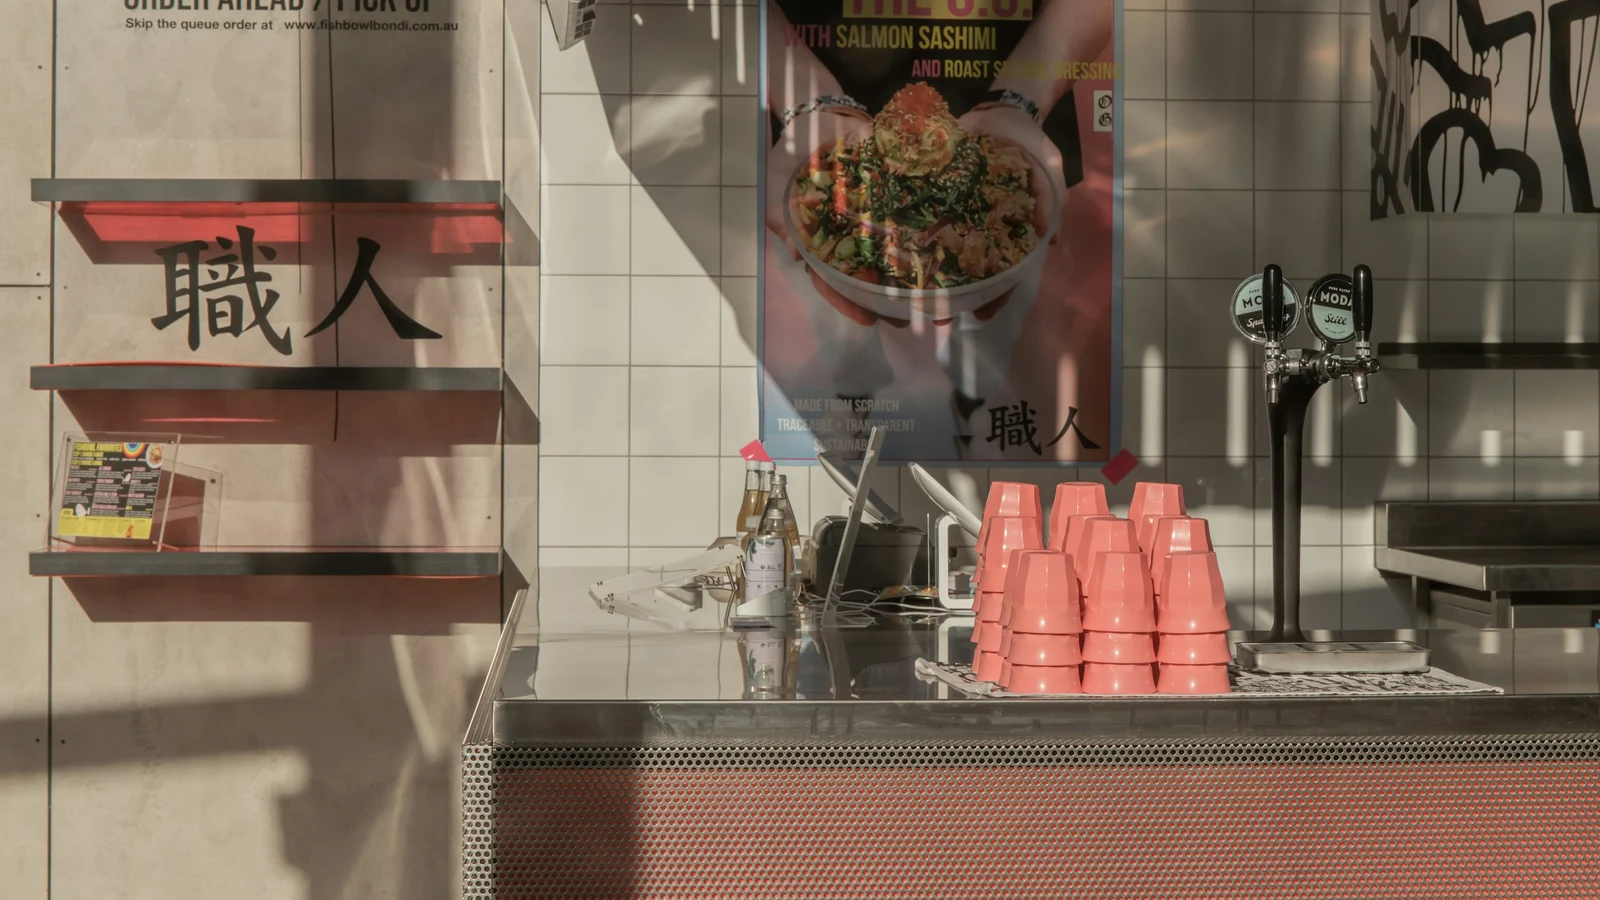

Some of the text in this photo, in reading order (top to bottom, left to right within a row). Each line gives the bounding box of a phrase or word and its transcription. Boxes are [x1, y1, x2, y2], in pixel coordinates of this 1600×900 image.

[125, 18, 459, 32] Skip the queue order at www.fishbowlbondi.com.au
[784, 24, 996, 50] WITH SALMON SASHIMI
[911, 60, 941, 78] AND
[944, 60, 989, 79] ROAST
[1053, 62, 1122, 81] DRESSING
[150, 224, 443, 356] 職人
[1324, 313, 1347, 326] Still
[794, 399, 900, 412] MADE FROM SCRATCH
[777, 418, 833, 432] TRACEABLE
[985, 400, 1102, 456] 職人
